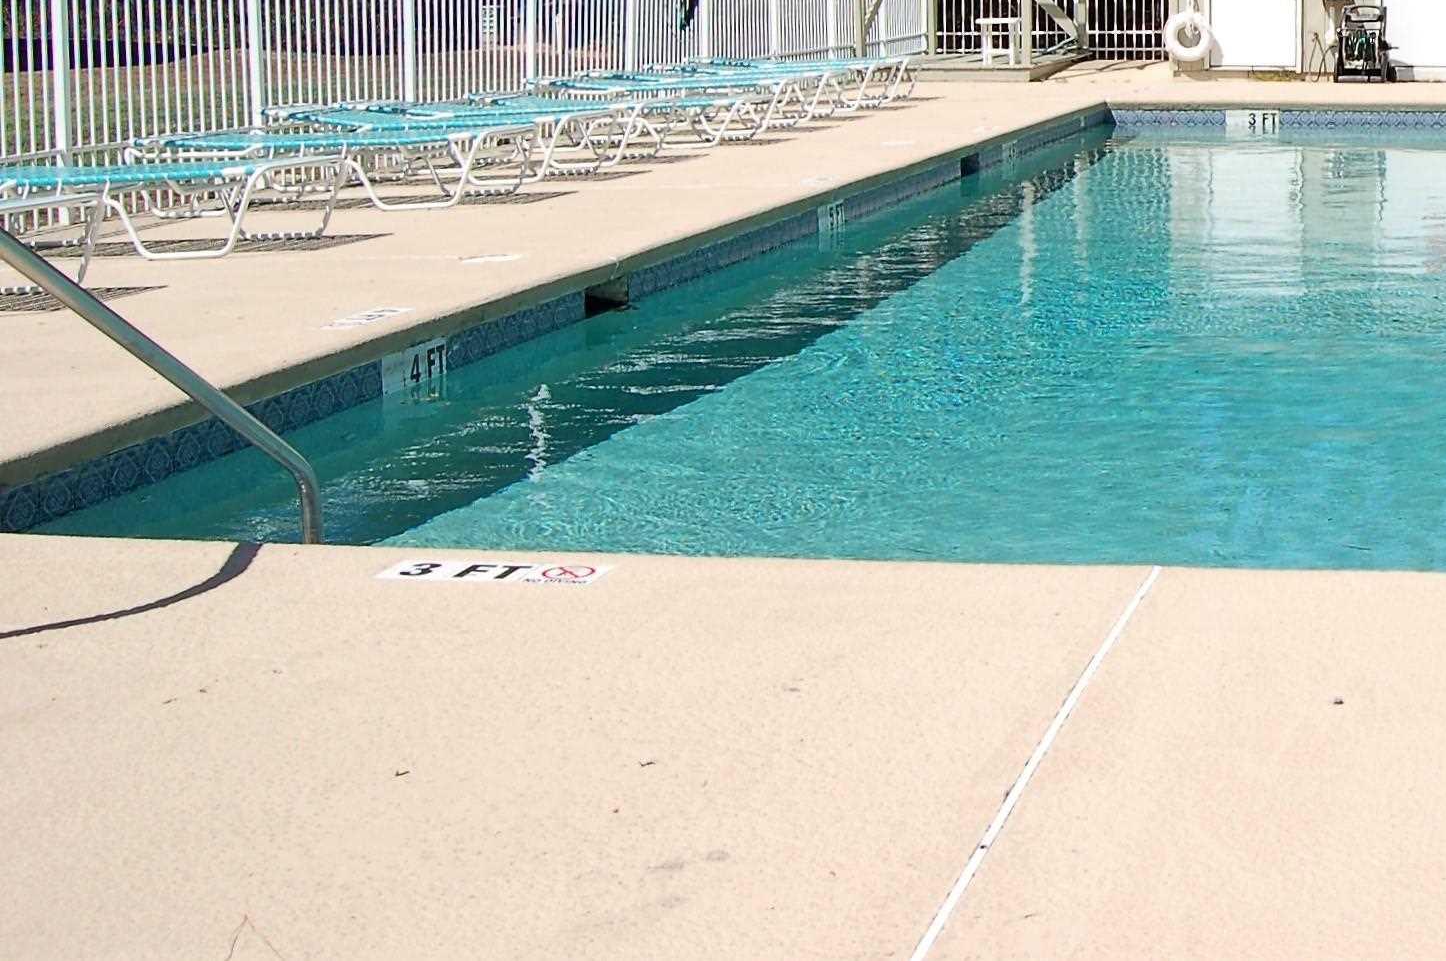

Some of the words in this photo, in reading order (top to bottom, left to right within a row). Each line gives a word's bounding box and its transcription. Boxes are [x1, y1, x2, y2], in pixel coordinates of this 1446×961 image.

[1248, 112, 1257, 126] 3
[1262, 112, 1277, 127] FT
[410, 353, 421, 383] 4
[427, 343, 447, 379] FT
[399, 562, 442, 576] 3
[452, 564, 533, 579] FT
